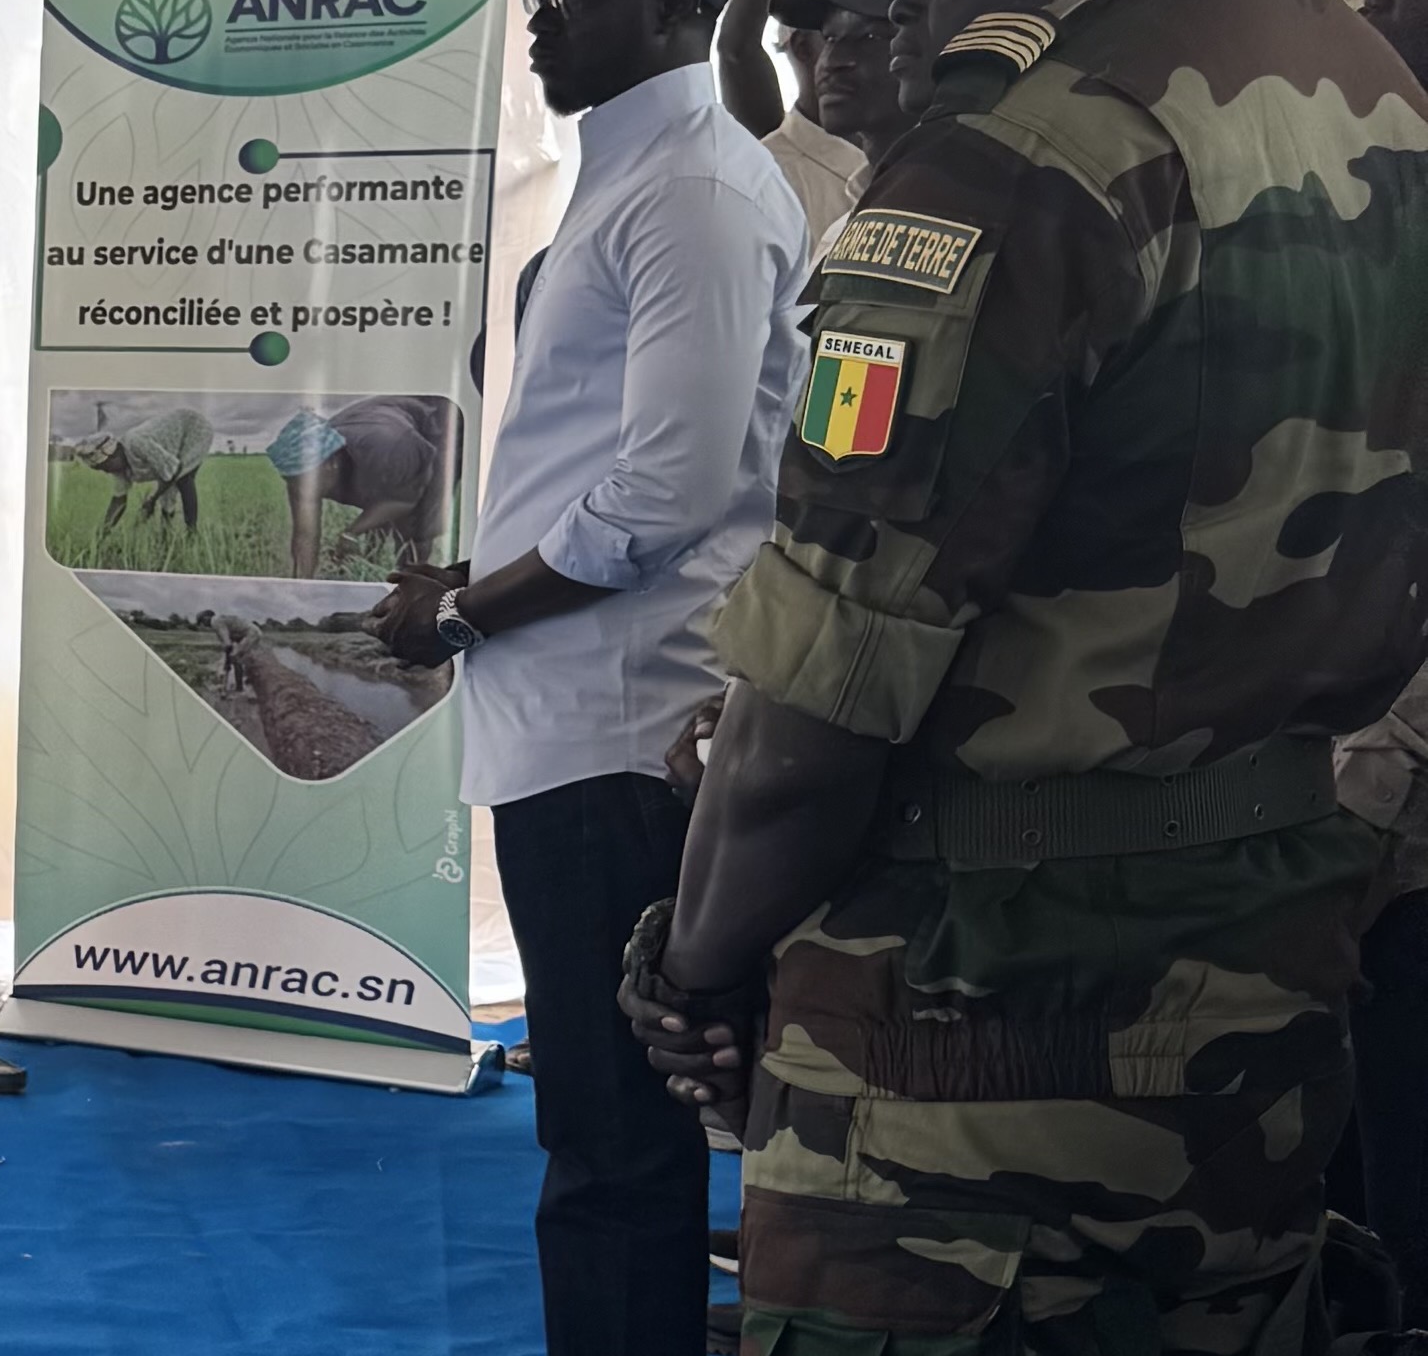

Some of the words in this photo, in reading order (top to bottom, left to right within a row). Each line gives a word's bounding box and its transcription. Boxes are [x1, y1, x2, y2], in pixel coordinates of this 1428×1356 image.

[76, 181, 134, 206] Une
[143, 182, 253, 211] agence
[263, 175, 463, 209] performante
[47, 244, 85, 266] au
[93, 238, 199, 266] service
[207, 237, 294, 265] d'une
[304, 238, 485, 265] Casamance
[872, 223, 908, 266] DE
[897, 226, 968, 279] TERRE
[78, 298, 241, 327] réconciliée
[251, 302, 282, 327] et
[292, 299, 434, 333] prospère
[825, 337, 895, 360] SENEGAL
[74, 944, 417, 1006] www.anrac.sn
